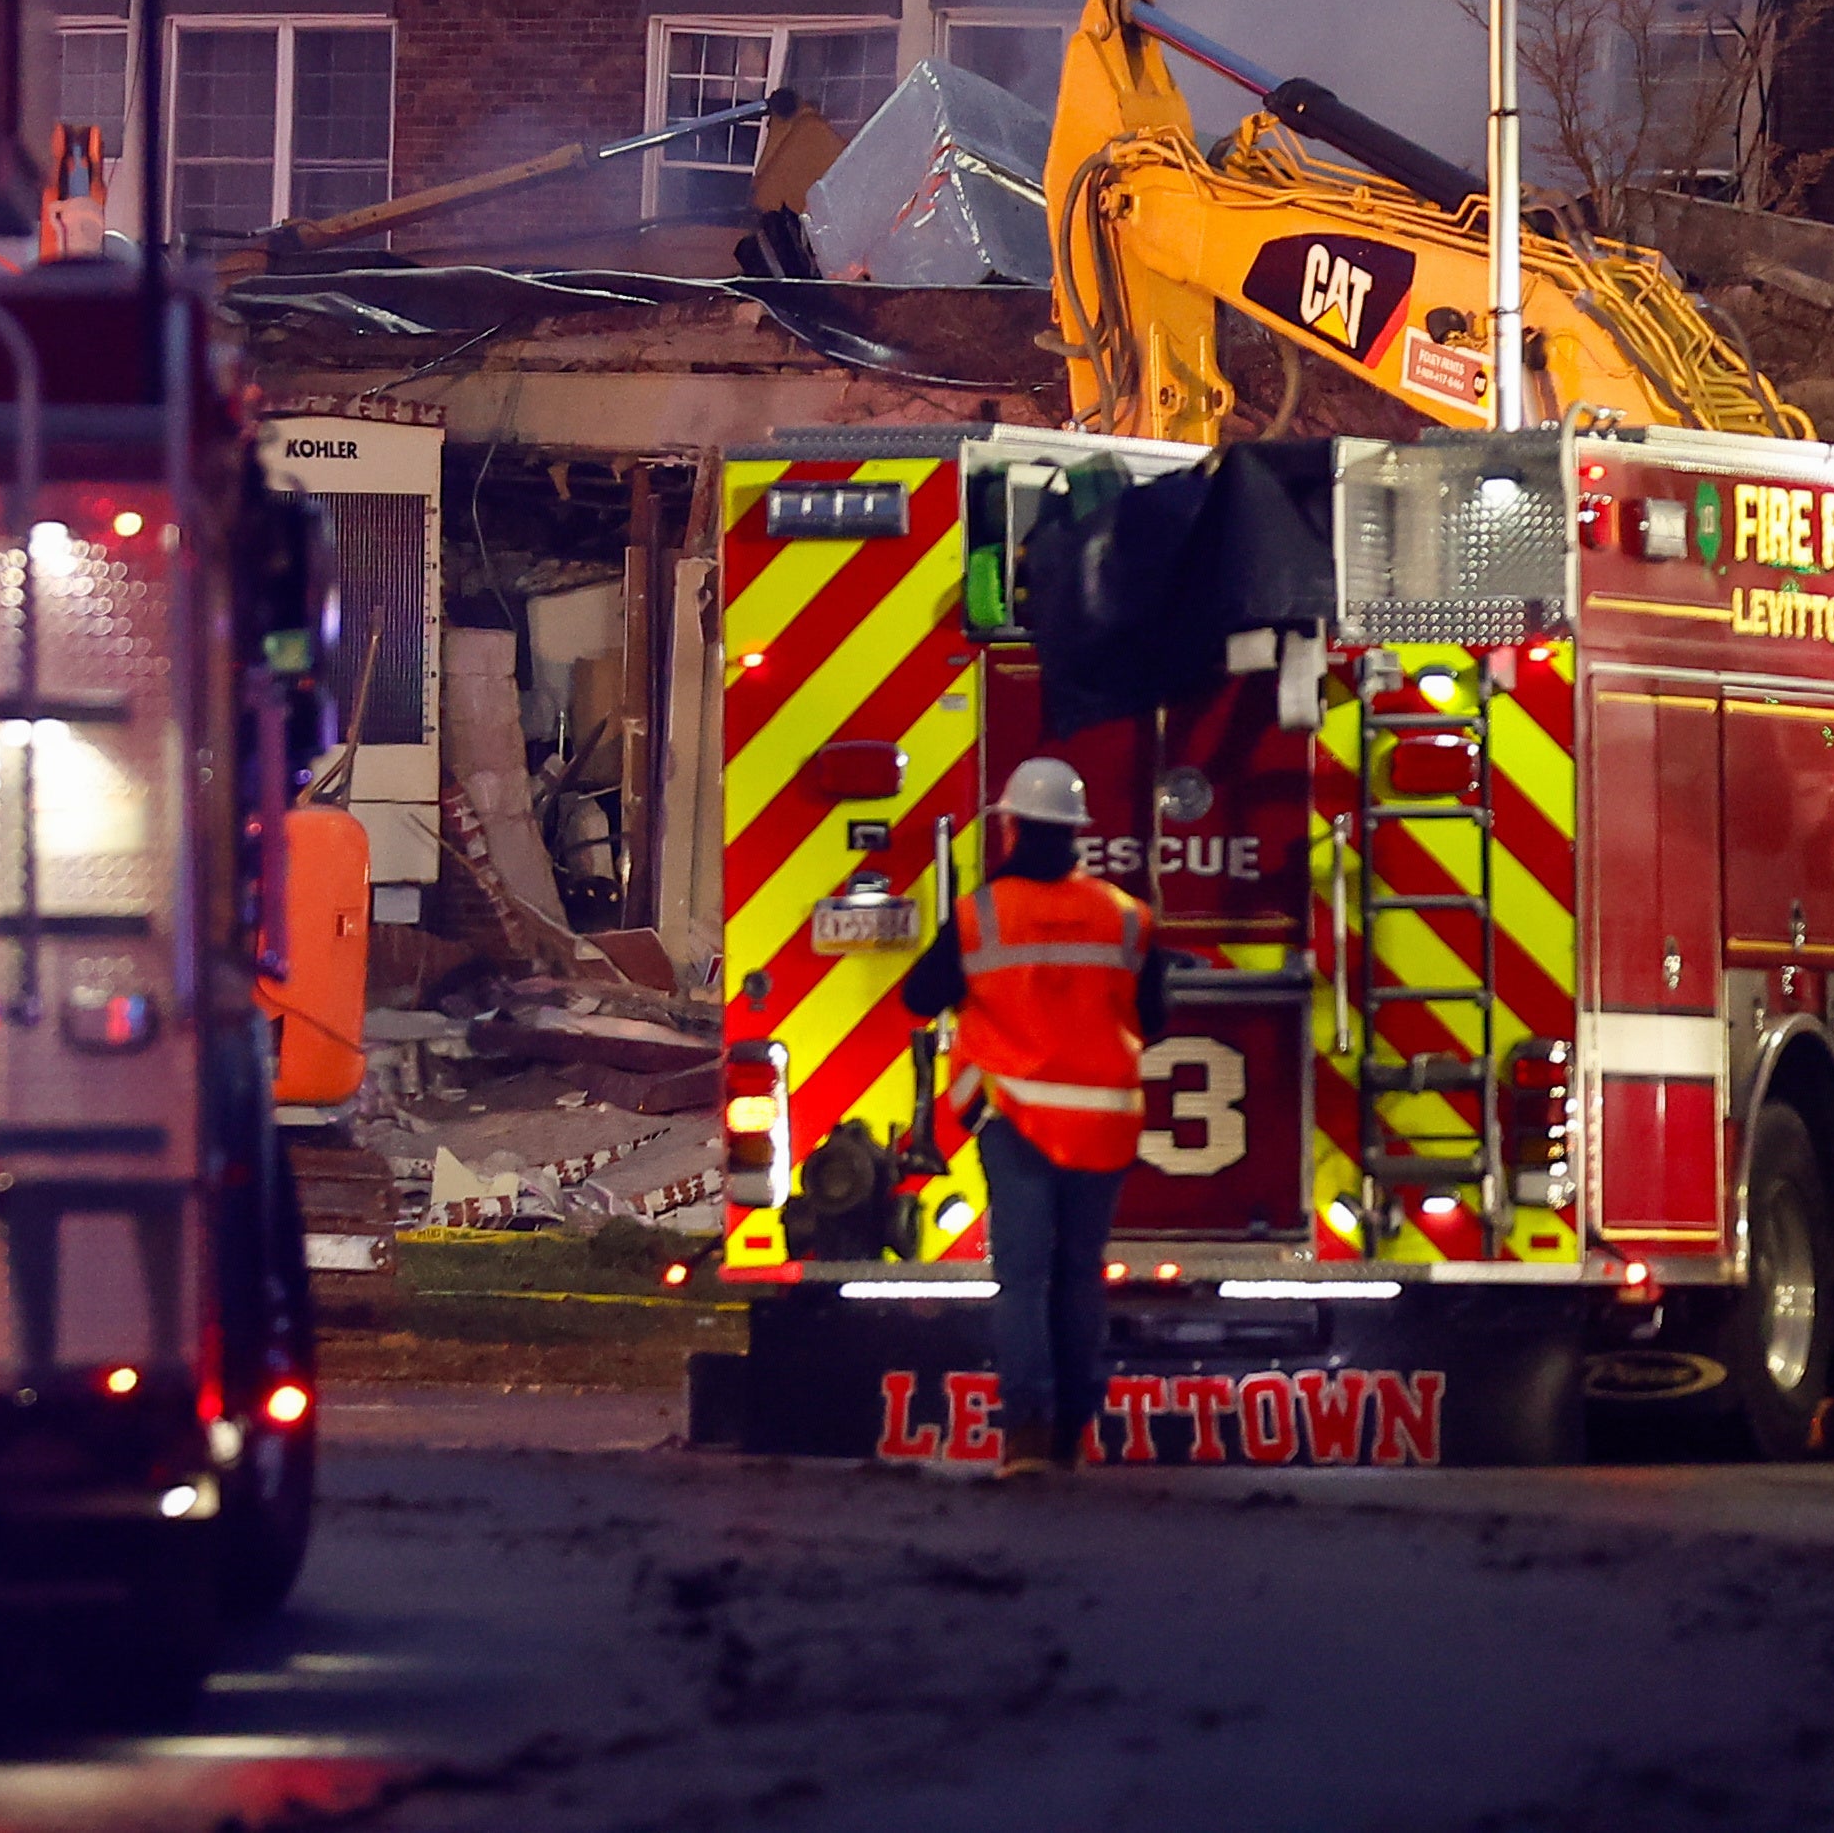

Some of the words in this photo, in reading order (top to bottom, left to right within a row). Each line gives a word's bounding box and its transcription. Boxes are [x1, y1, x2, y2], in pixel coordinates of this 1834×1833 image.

[1300, 243, 1374, 350] CAT
[285, 438, 359, 460] KOHLER
[1733, 483, 1815, 568] FIRE
[1074, 834, 1261, 881] ESCUE
[876, 1368, 1446, 1467] LETTOWN
